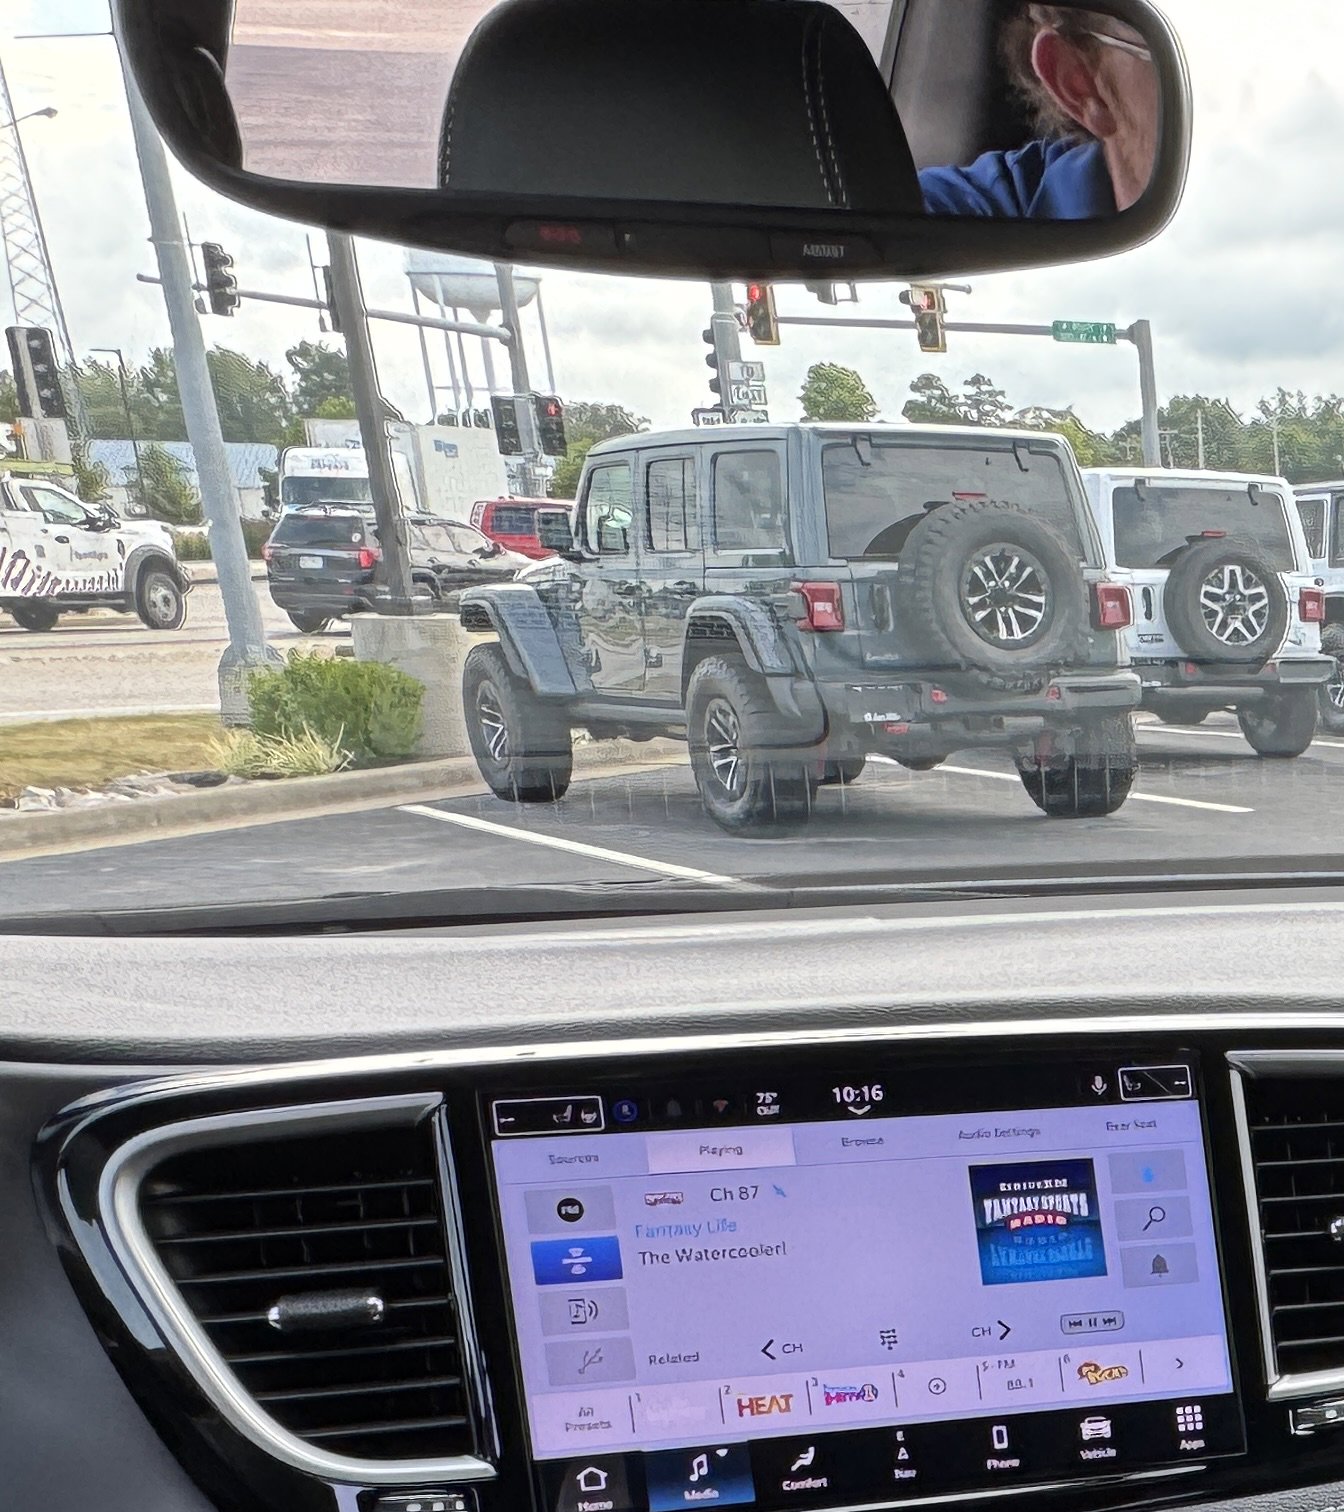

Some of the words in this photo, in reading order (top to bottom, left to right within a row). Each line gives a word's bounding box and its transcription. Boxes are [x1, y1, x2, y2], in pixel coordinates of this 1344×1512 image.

[832, 1084, 884, 1103] 10:16
[710, 1187, 735, 1202] Ch
[738, 1185, 760, 1201] 87
[638, 1250, 671, 1267] The
[971, 1326, 992, 1339] CH
[781, 1342, 804, 1355] CH
[736, 1392, 795, 1418] HEAT
